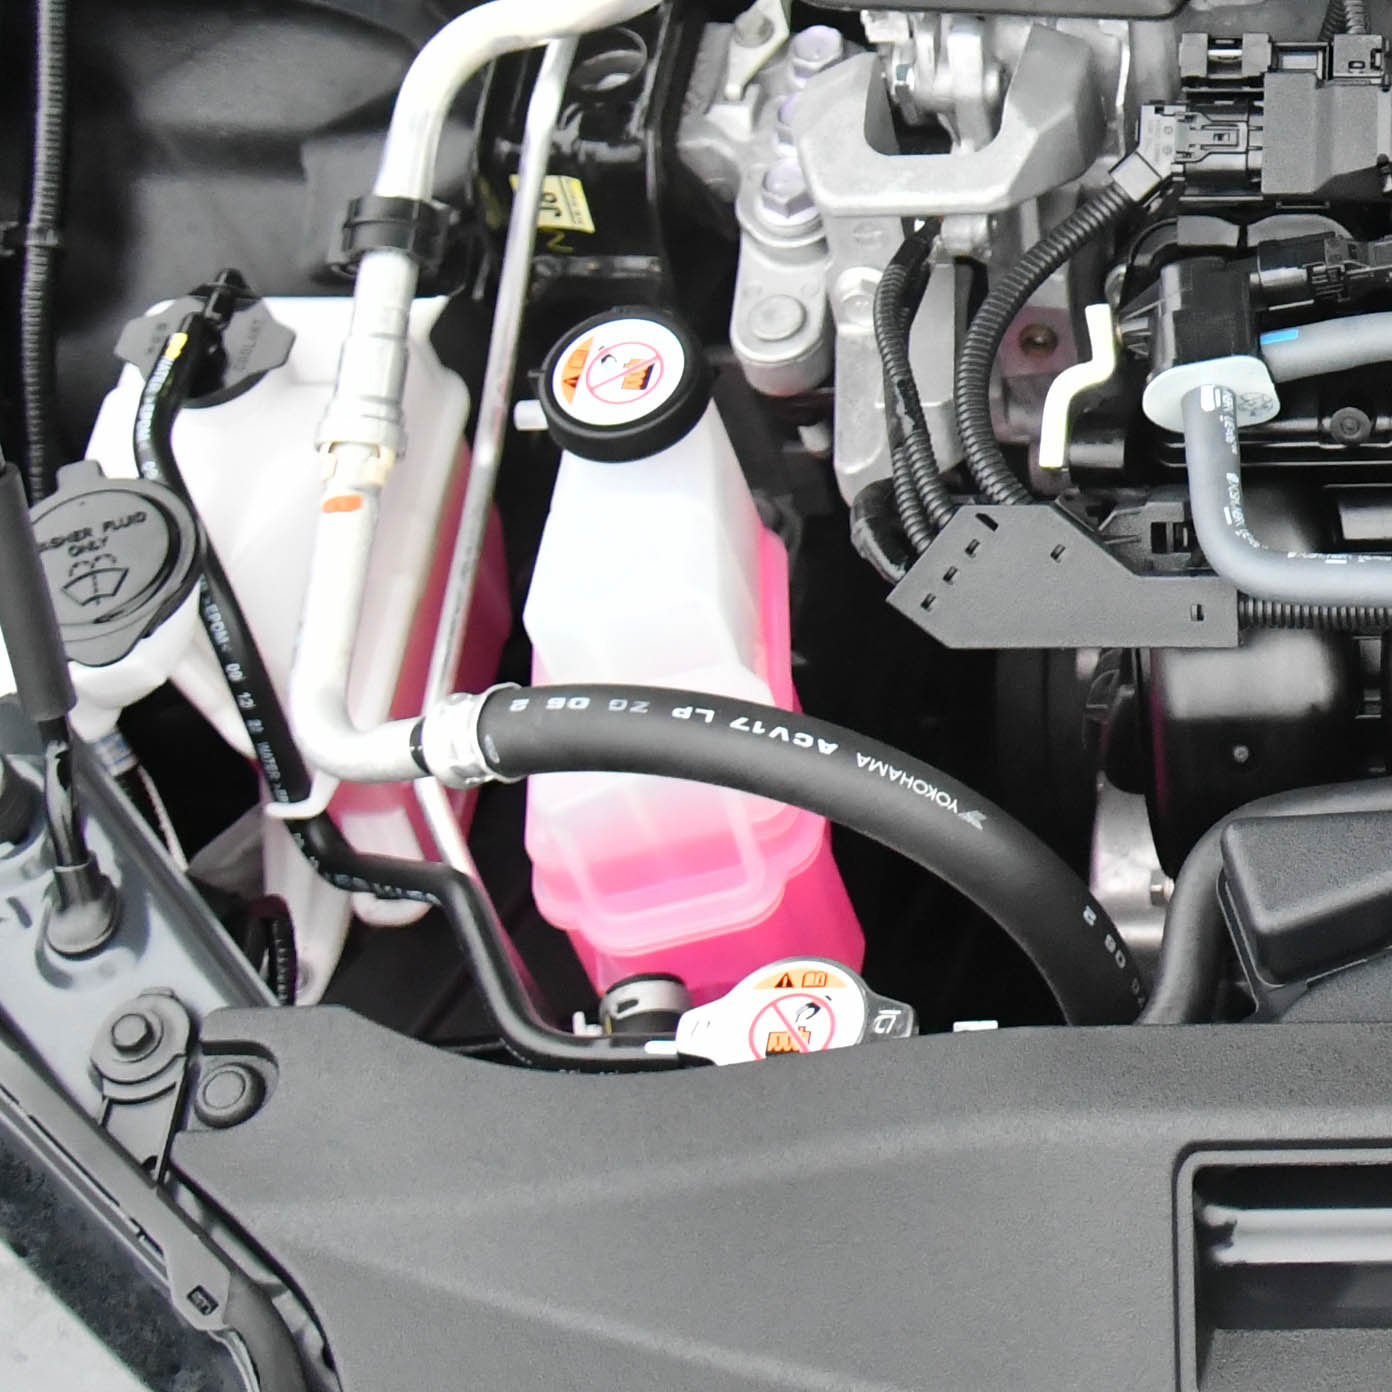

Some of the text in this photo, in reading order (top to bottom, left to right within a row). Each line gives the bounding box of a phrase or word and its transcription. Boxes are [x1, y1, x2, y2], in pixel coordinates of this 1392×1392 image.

[103, 511, 148, 531] FLUID
[68, 535, 110, 558] ONLY
[509, 697, 530, 712] 2
[671, 706, 716, 724] LP
[729, 716, 840, 756] ACV17
[855, 751, 960, 815] YOKOHAMA
